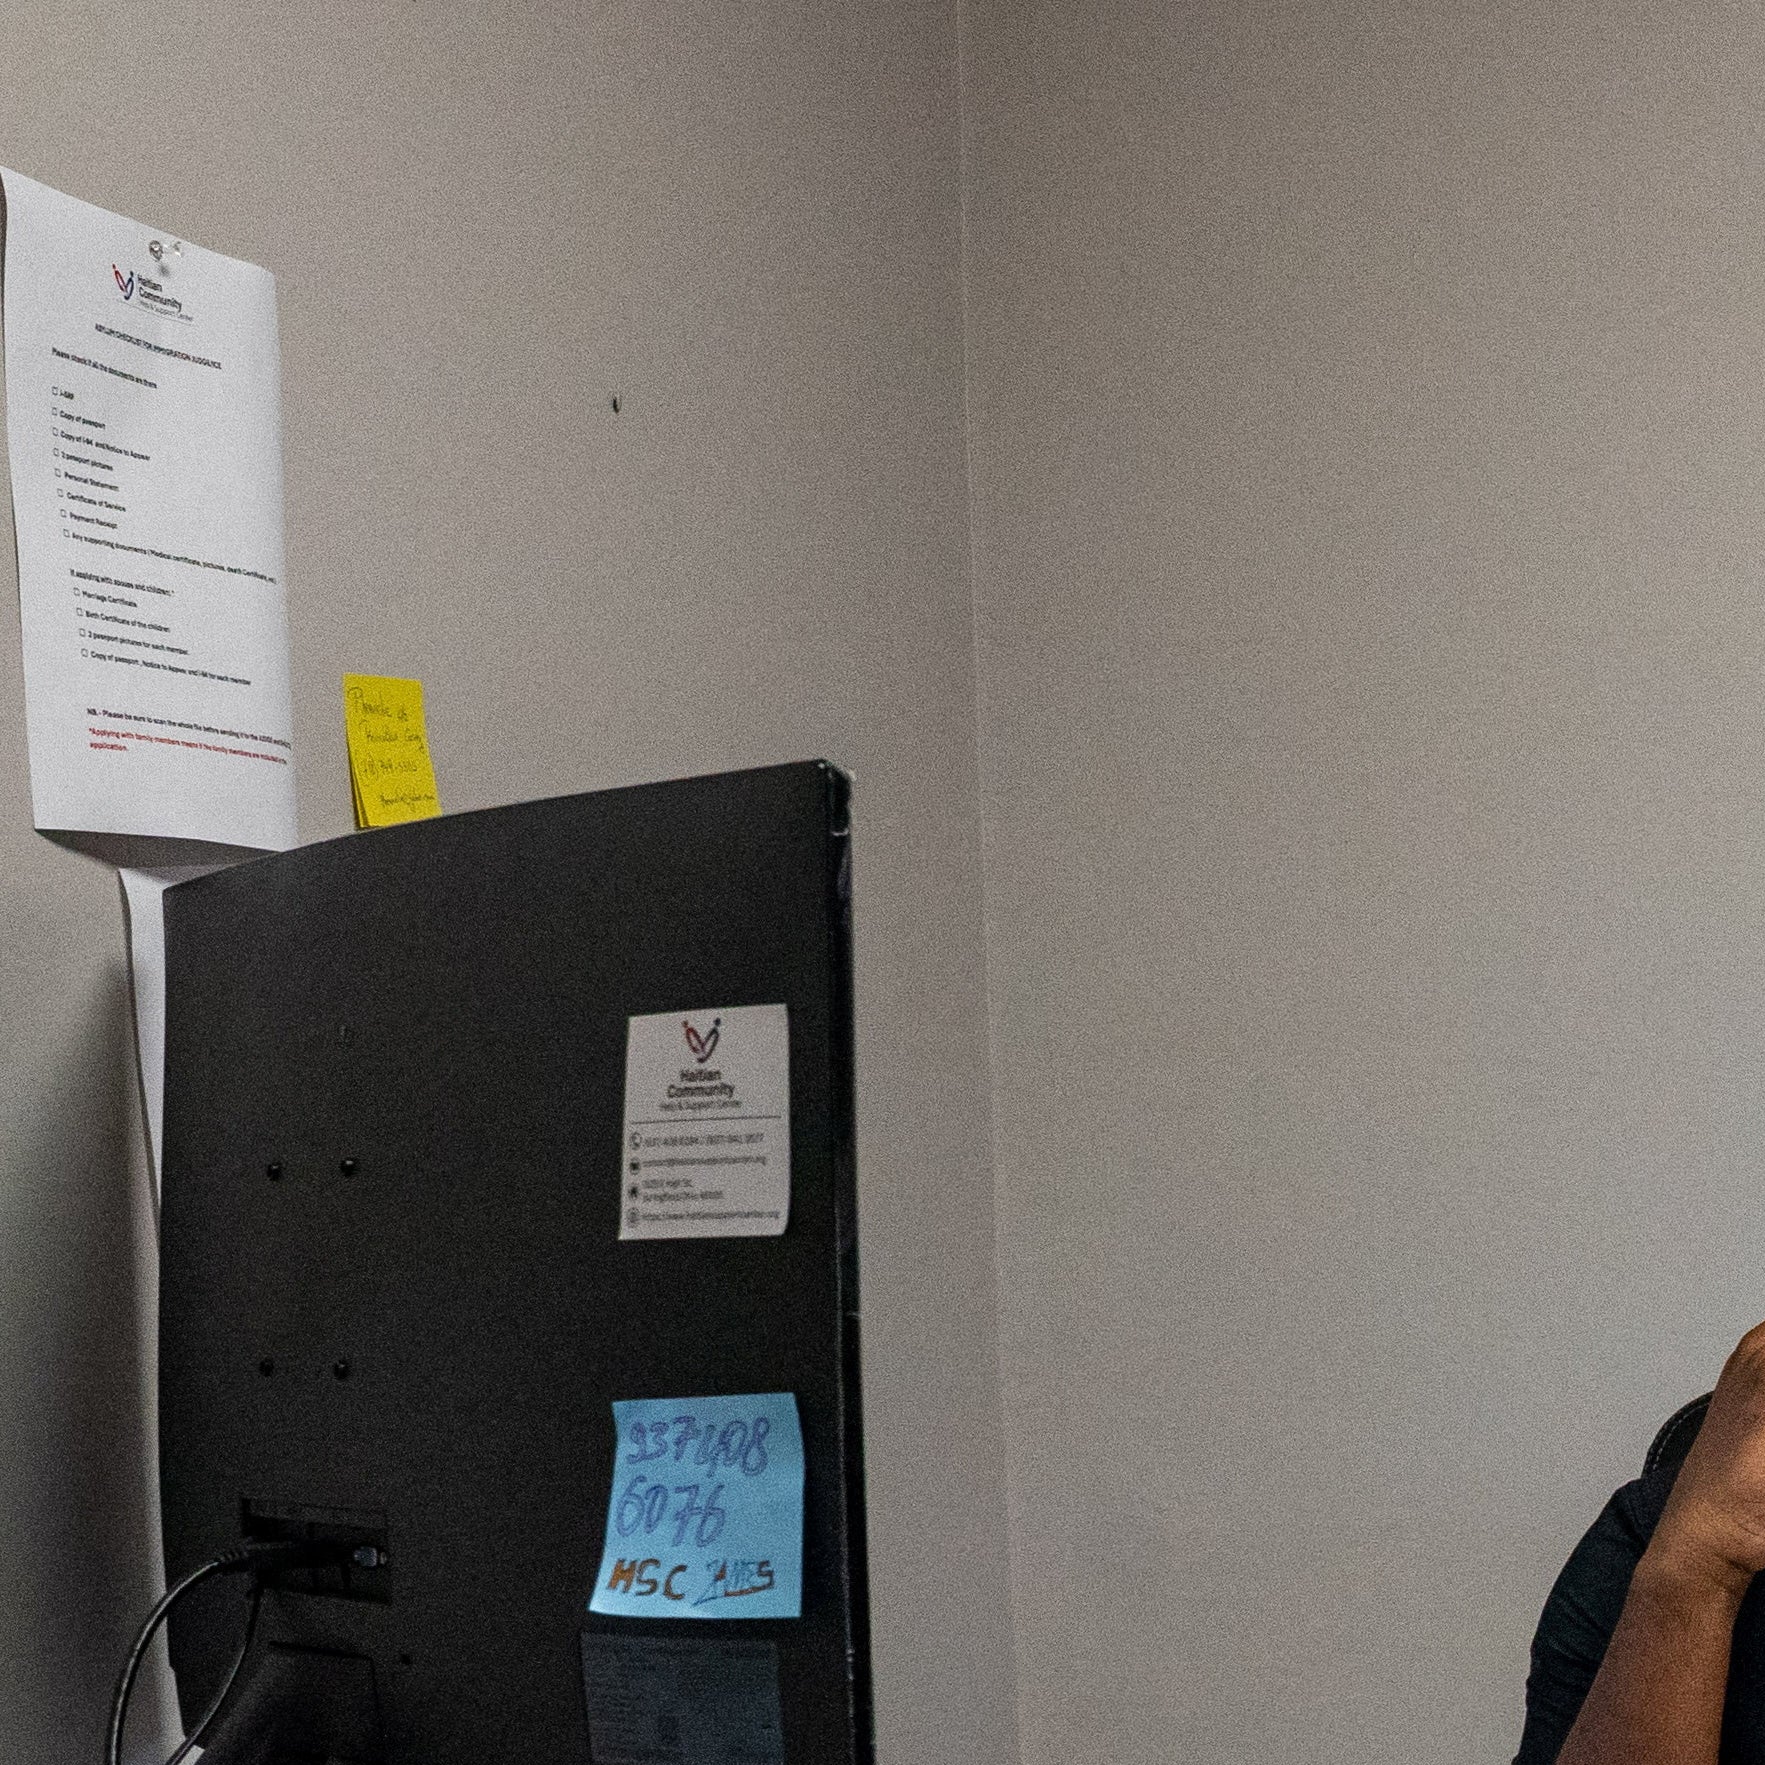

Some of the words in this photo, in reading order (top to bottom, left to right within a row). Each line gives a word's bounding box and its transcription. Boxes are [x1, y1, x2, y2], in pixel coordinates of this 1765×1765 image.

[139, 286, 182, 312] Community
[680, 1069, 721, 1082] Haitian
[668, 1083, 735, 1099] Community
[616, 1475, 725, 1548] 6076
